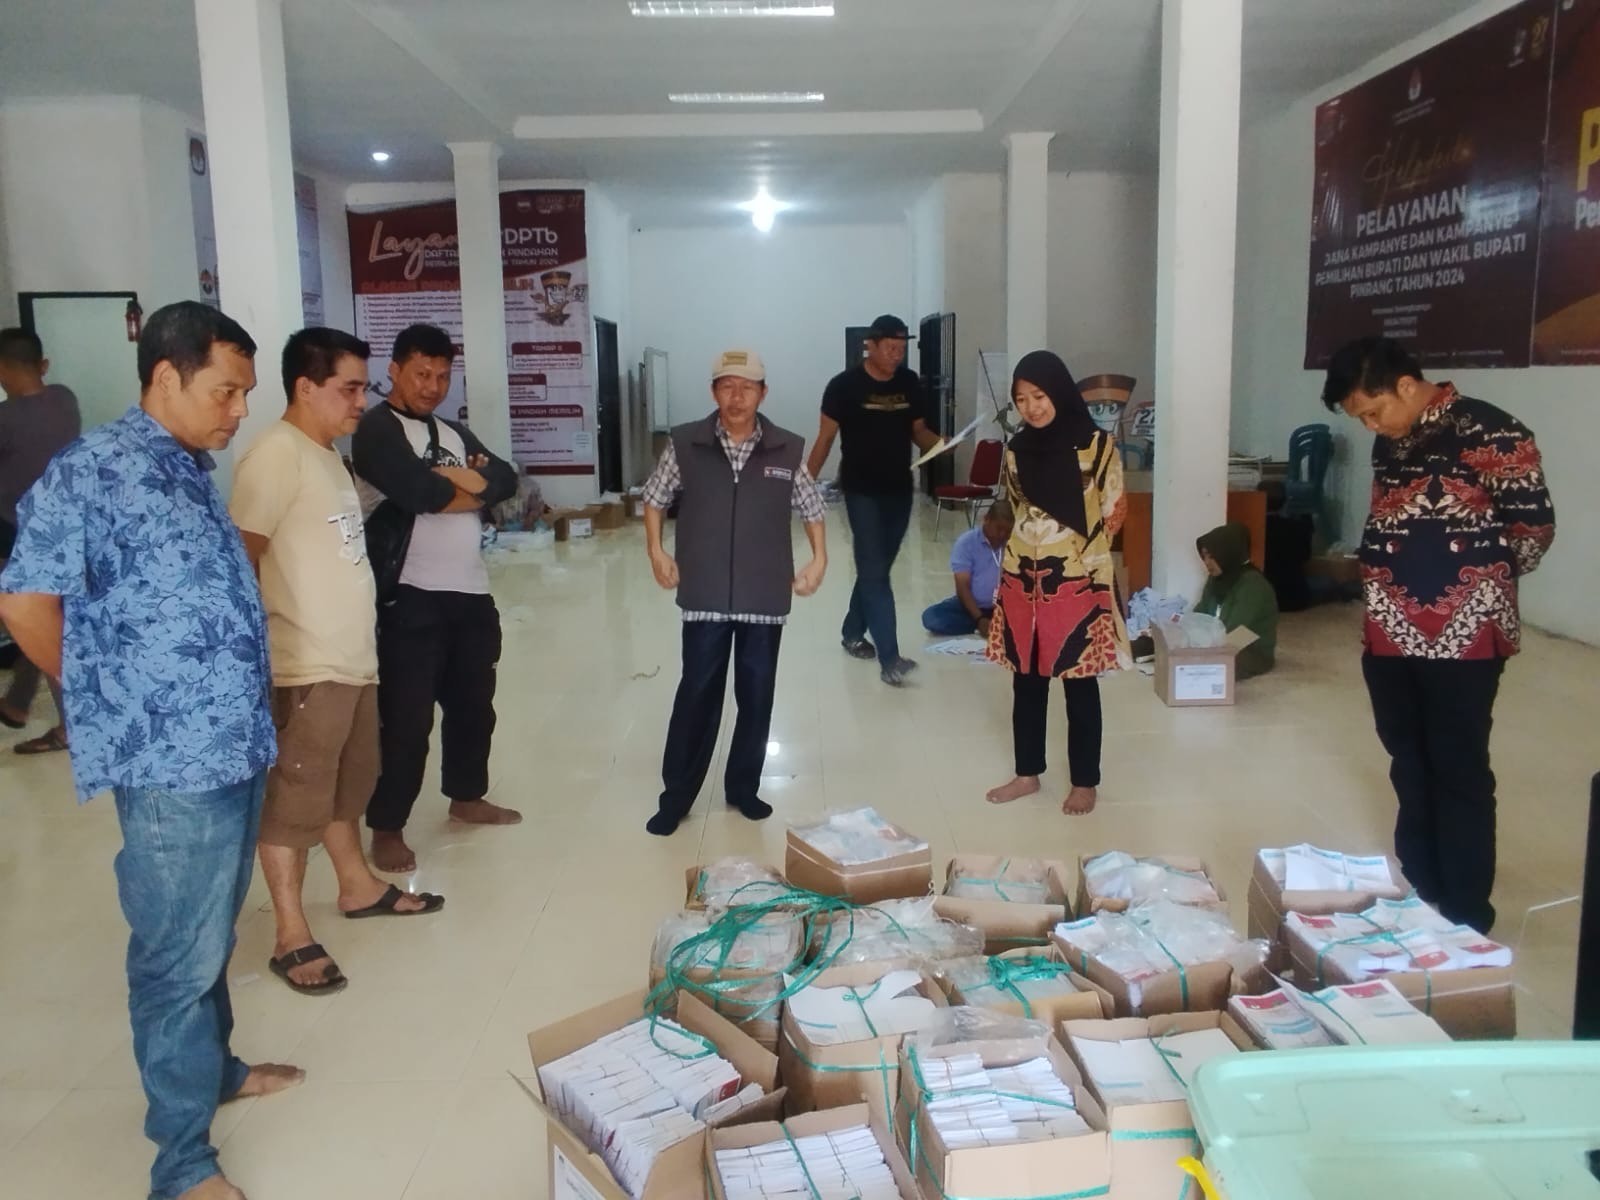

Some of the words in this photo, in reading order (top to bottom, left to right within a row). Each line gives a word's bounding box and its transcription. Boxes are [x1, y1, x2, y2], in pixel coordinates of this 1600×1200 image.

[1357, 184, 1467, 237] PELAYANAN
[505, 227, 558, 245] DPTb
[1351, 235, 1408, 261] KAMPANYE
[1409, 229, 1435, 249] DAN
[1365, 256, 1402, 278] BUPATI
[1403, 252, 1427, 271] DAN
[1430, 243, 1471, 266] WAKIL
[1473, 233, 1527, 259] BUPATI
[1396, 271, 1434, 291] TAHUN
[1436, 268, 1465, 288] 2024
